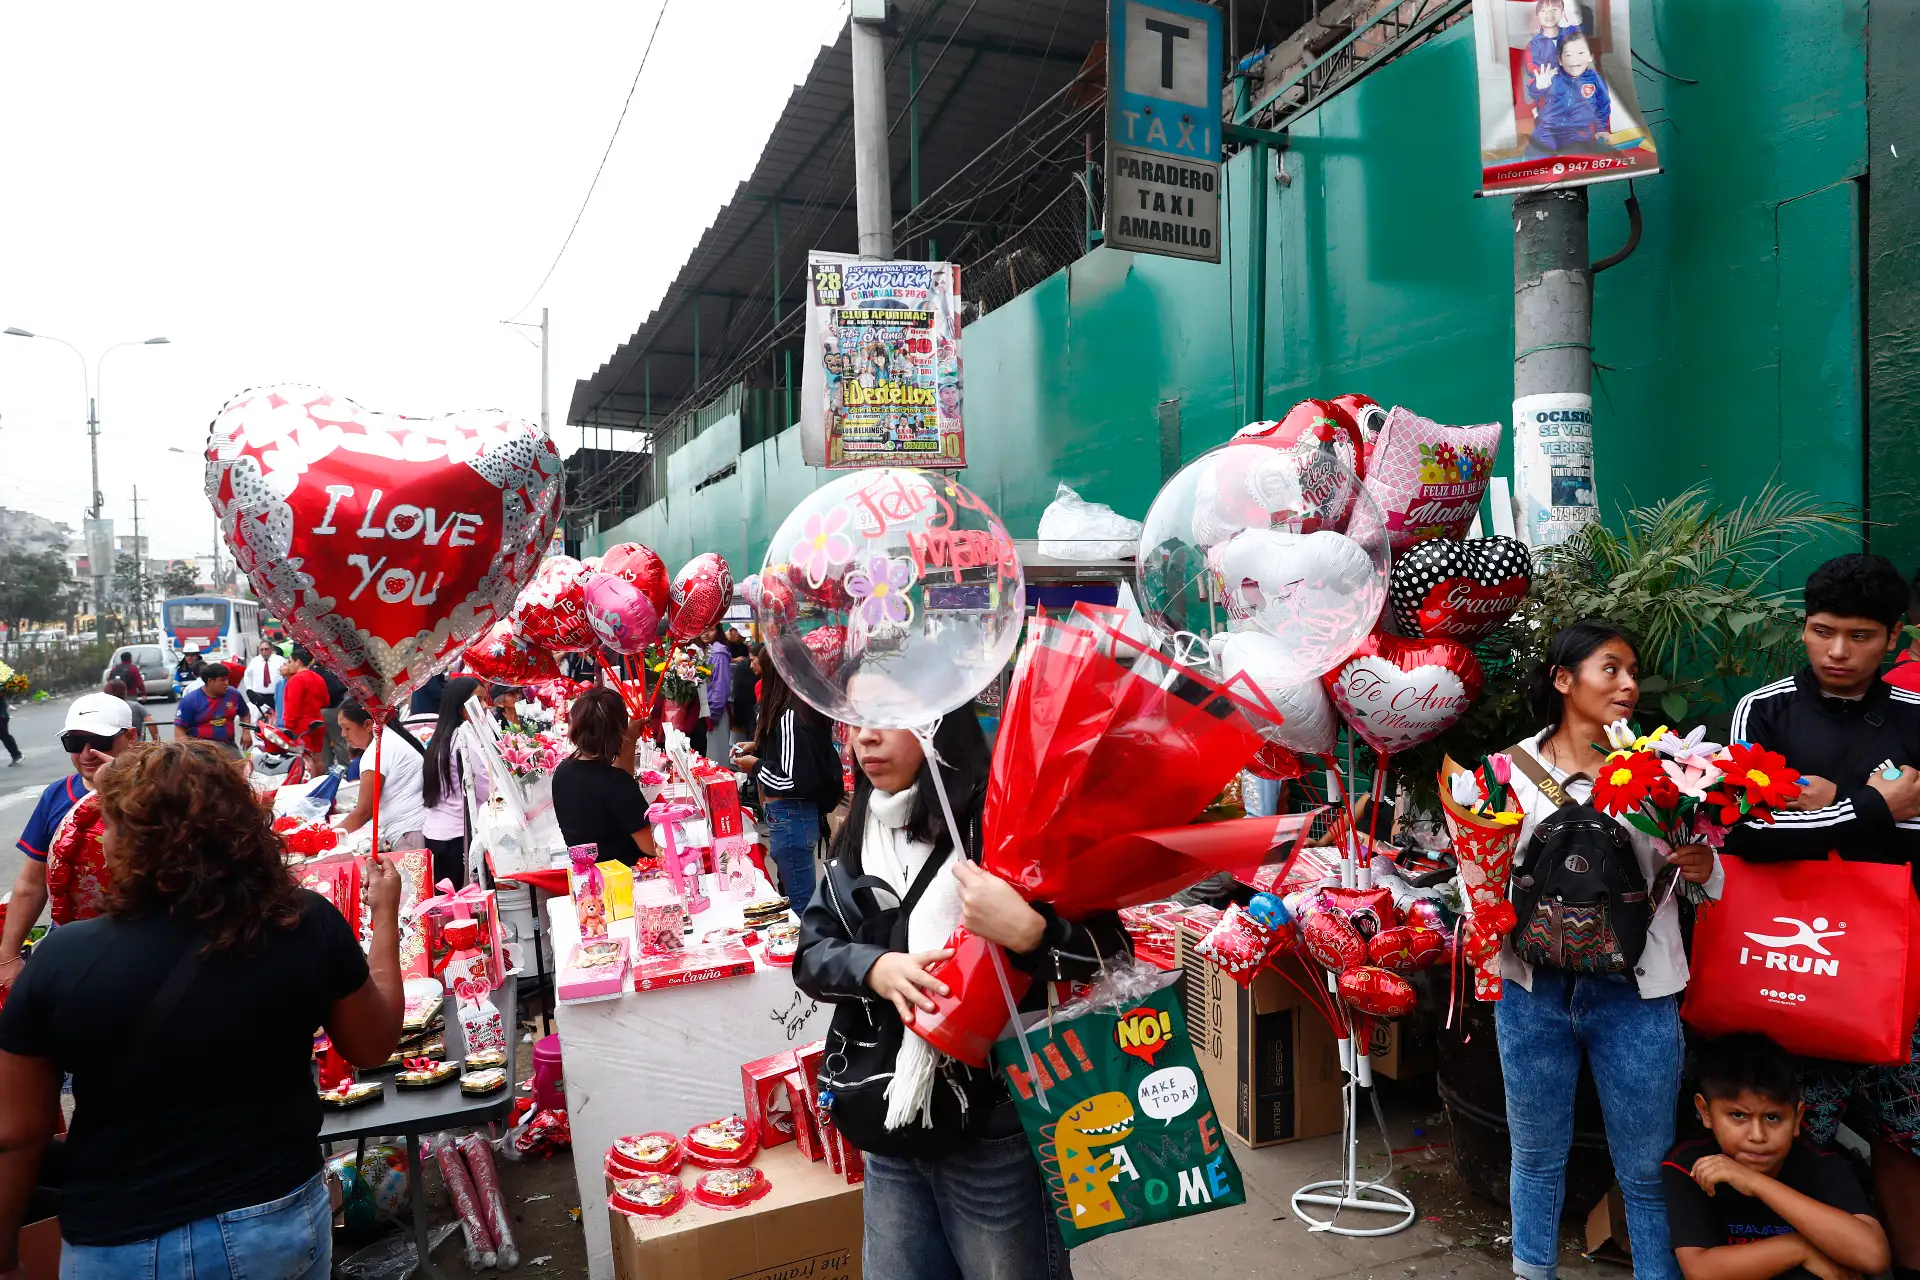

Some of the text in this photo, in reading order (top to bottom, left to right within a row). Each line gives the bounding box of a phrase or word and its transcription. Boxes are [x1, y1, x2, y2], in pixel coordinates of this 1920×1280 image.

[1145, 18, 1189, 90] T
[1122, 110, 1211, 154] TAXI
[1116, 156, 1214, 193] PARADERO
[1497, 166, 1548, 181] Informes:
[1568, 161, 1588, 172] 947
[1592, 158, 1612, 169] 867
[1138, 189, 1194, 218] TAXI
[1118, 215, 1211, 249] AMARILLO
[819, 265, 836, 273] SAB
[844, 269, 933, 291] BANDURIA
[861, 265, 899, 273] FESTIVAL
[815, 273, 842, 291] 28
[820, 290, 840, 299] MAR
[851, 289, 927, 300] CARNAVALES 2026
[841, 310, 927, 321] CLUB APURIMAC
[905, 338, 933, 354] 10
[849, 379, 936, 406] Destellos
[1536, 409, 1592, 423] OCASIÓ
[1539, 424, 1559, 437] SE
[1422, 485, 1450, 497] FELIZ
[1451, 484, 1465, 496] DIA
[1468, 482, 1477, 493] DE
[312, 484, 485, 547] I LOVE
[1403, 499, 1480, 526] Madre
[1551, 508, 1570, 521] 979
[347, 553, 445, 607] YOU
[553, 597, 576, 615] Te
[1440, 582, 1518, 614] Gracias
[553, 609, 587, 636] Amo
[1425, 614, 1479, 636] por
[547, 621, 592, 648] Mamá
[1348, 668, 1468, 712] Te Amo
[1232, 926, 1253, 946] Amo
[1740, 947, 1840, 977] I-RUN
[682, 969, 721, 983] Cariño
[1116, 1011, 1173, 1049] NO!
[1005, 1028, 1094, 1101] HI!
[1141, 1077, 1176, 1098] MAKE
[1152, 1084, 1198, 1108] TODAY
[1273, 1101, 1281, 1136] DELUXE
[821, 1254, 849, 1271] the
